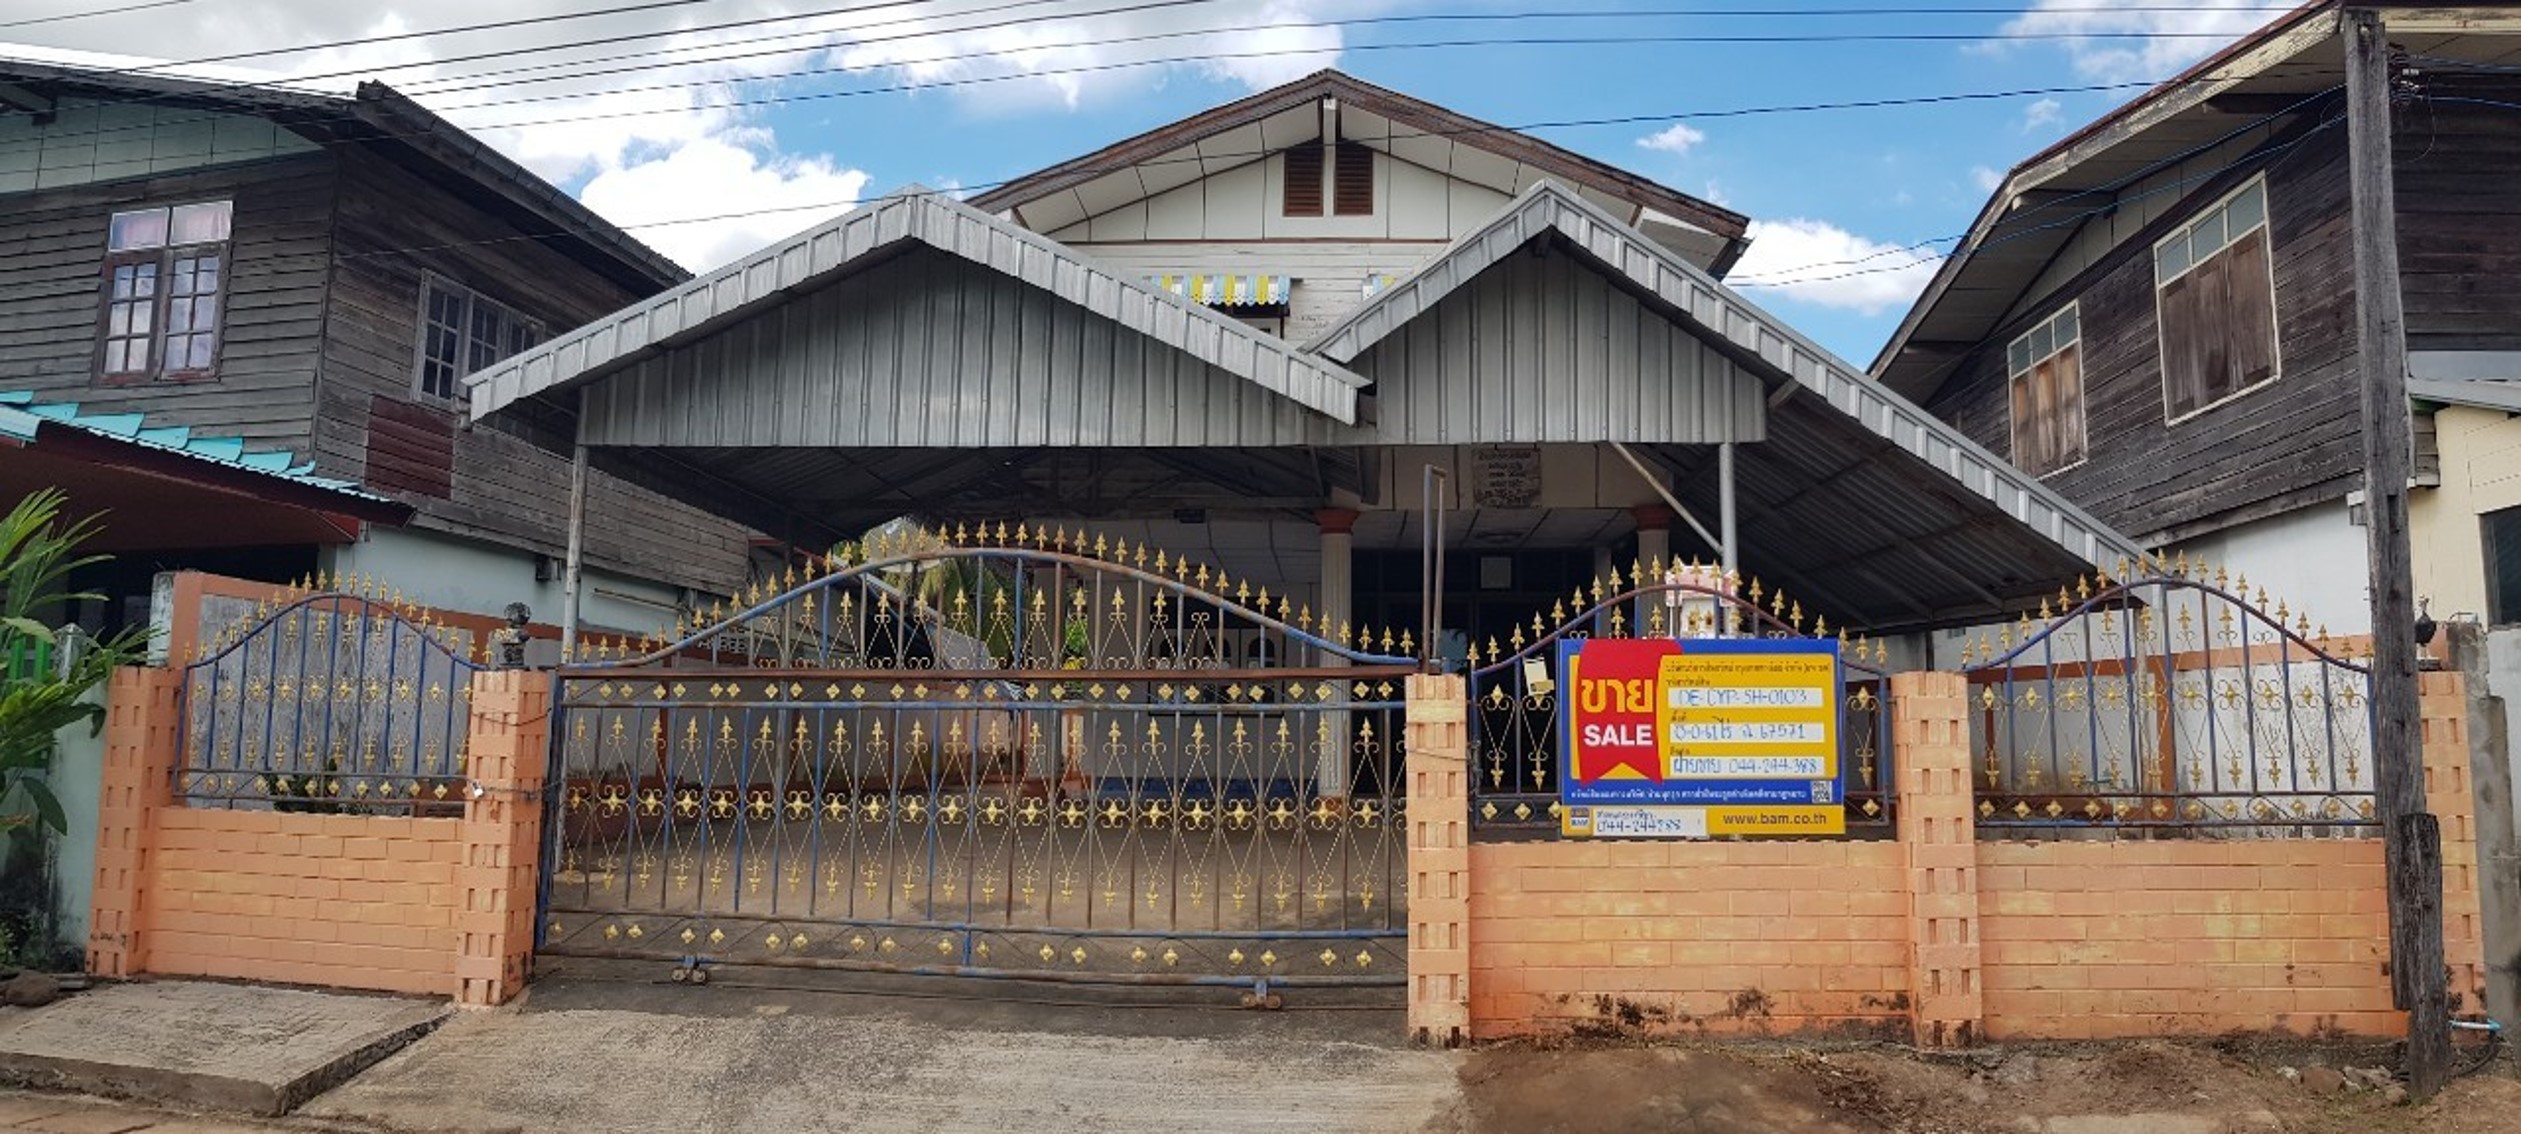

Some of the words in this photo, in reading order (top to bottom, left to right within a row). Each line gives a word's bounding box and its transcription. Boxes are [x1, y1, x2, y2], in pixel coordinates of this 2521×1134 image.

[1581, 679, 1653, 713] ขาย
[1584, 724, 1653, 747] SALE
[1723, 813, 1827, 825] www.bam.co.th
